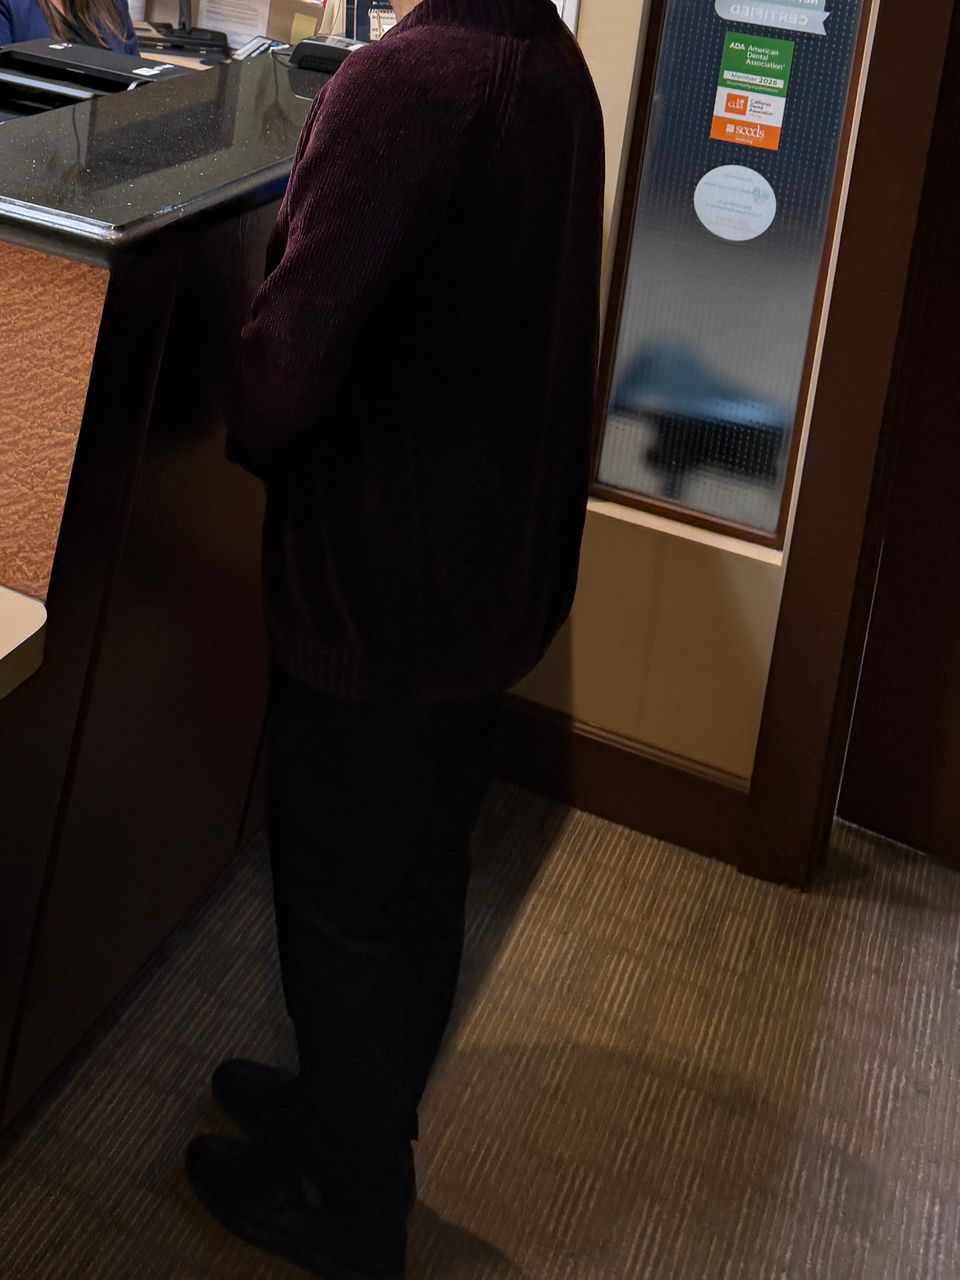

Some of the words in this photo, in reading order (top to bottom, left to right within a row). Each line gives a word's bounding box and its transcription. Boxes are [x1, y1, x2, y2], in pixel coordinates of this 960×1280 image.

[729, 41, 746, 51] ADA
[747, 45, 779, 56] American
[746, 51, 769, 60] Dental
